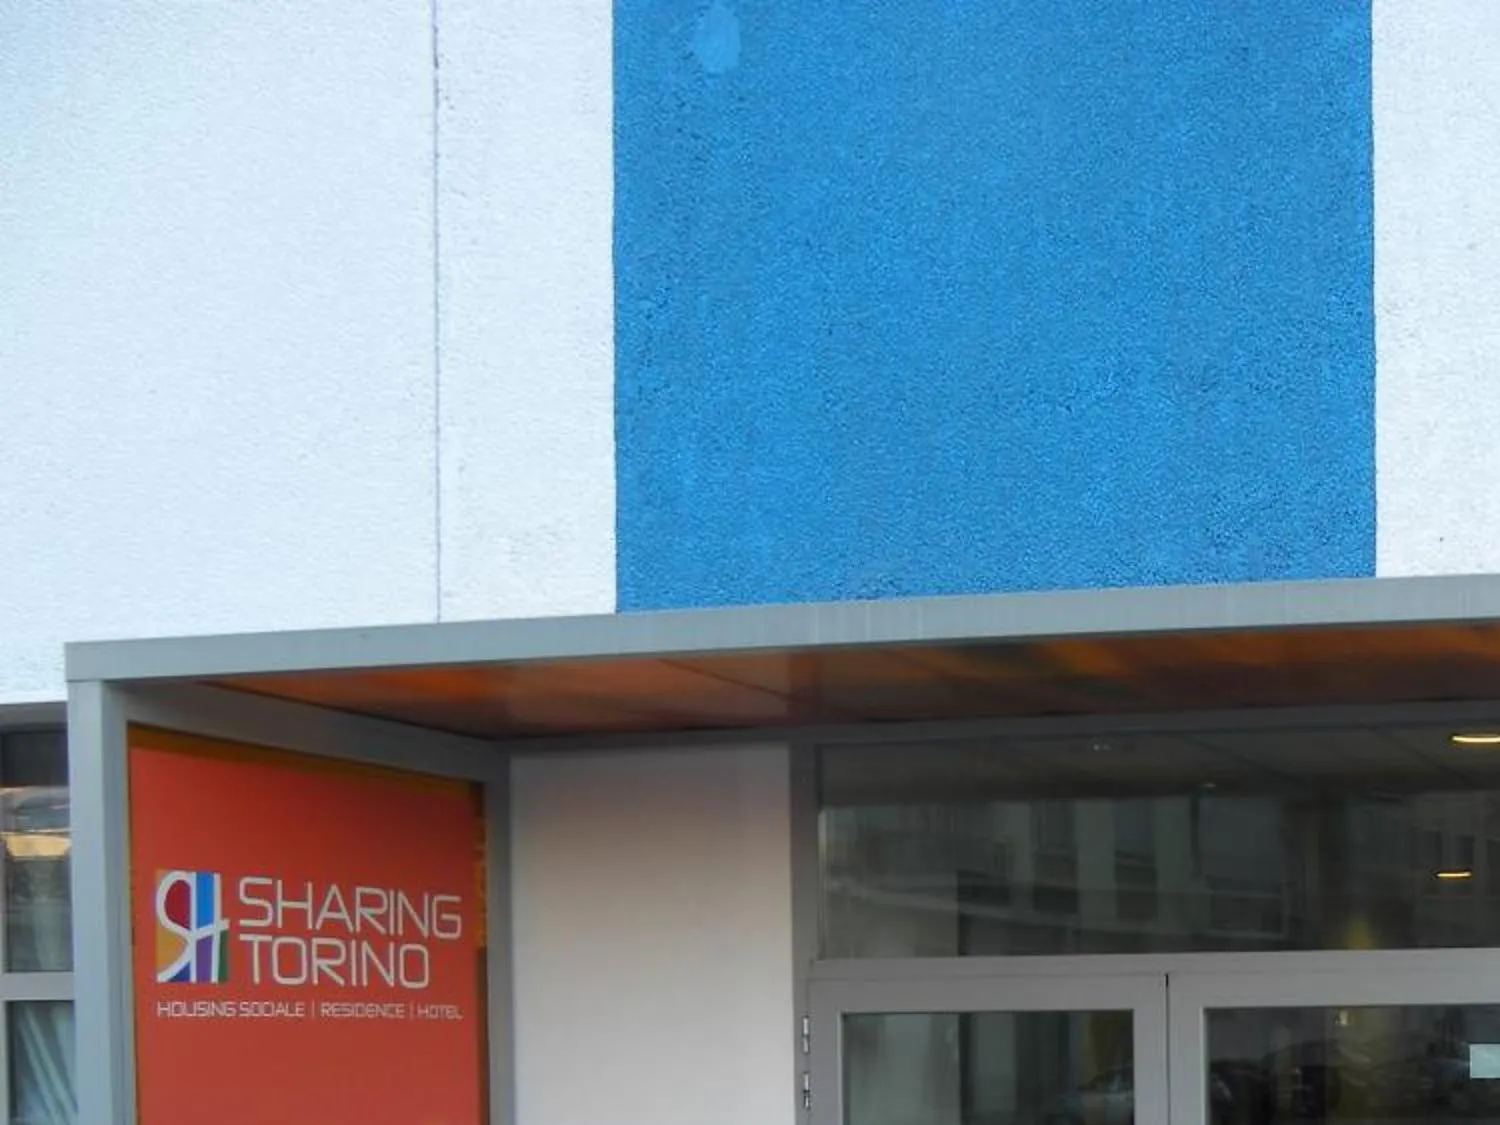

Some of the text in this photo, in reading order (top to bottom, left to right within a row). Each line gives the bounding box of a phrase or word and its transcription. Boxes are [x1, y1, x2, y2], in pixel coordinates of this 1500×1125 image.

[239, 877, 463, 939] SHARING
[239, 933, 430, 989] TORINO
[157, 1002, 464, 1021] HOUSING SOCIALE RESIDENCE HOTEL
